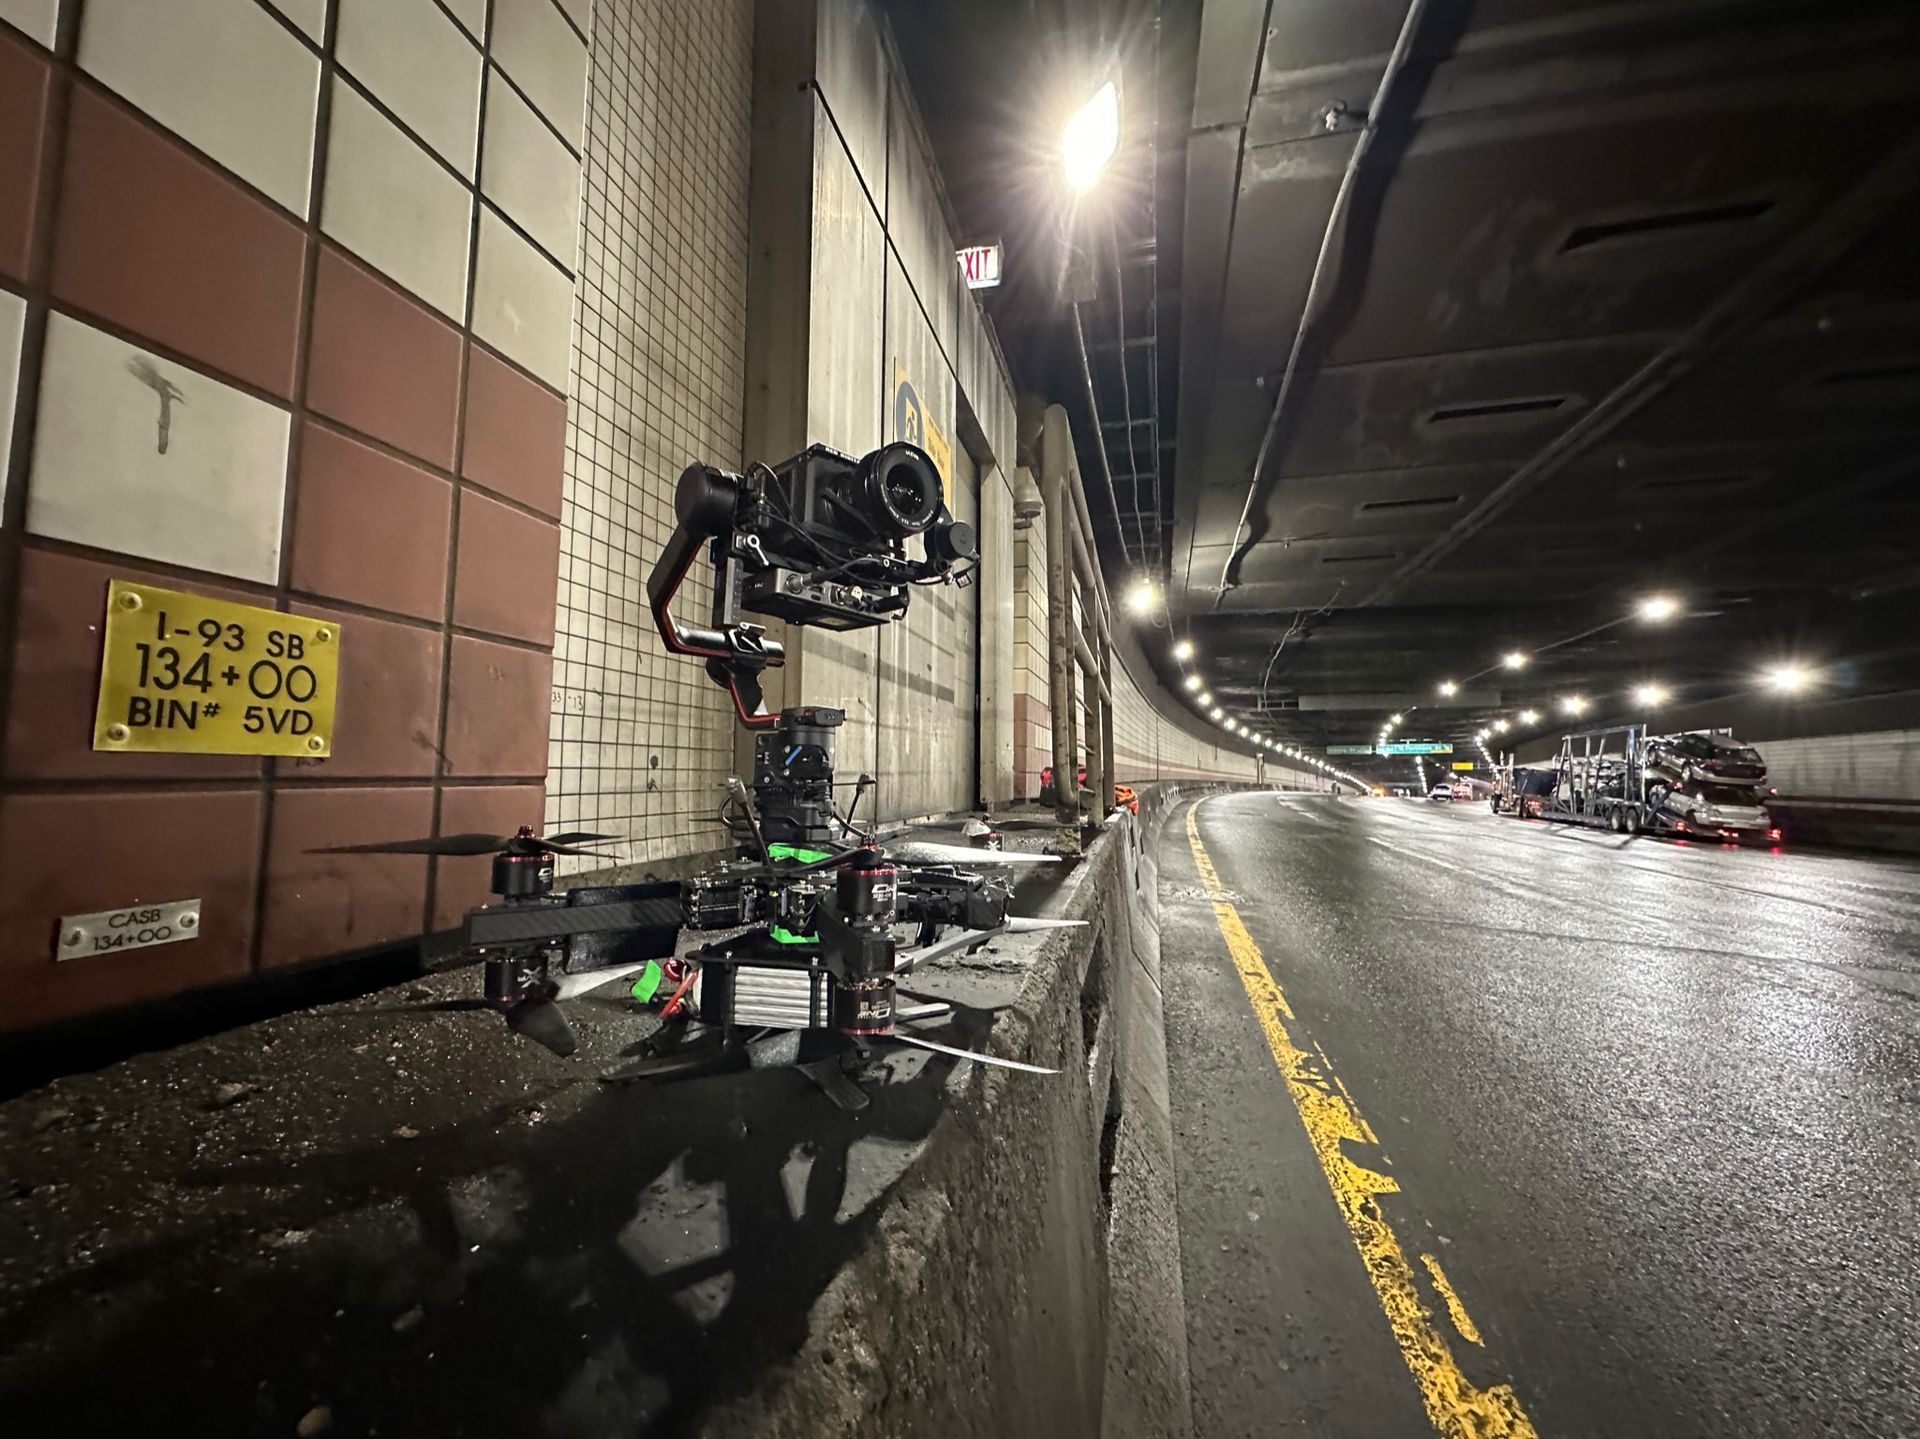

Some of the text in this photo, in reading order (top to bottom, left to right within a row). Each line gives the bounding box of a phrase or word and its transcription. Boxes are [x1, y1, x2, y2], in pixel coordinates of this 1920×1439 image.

[956, 249, 991, 280] XIT
[157, 611, 304, 660] I-93 SB
[127, 696, 313, 735] BIN# 5VD
[108, 909, 161, 928] CASB
